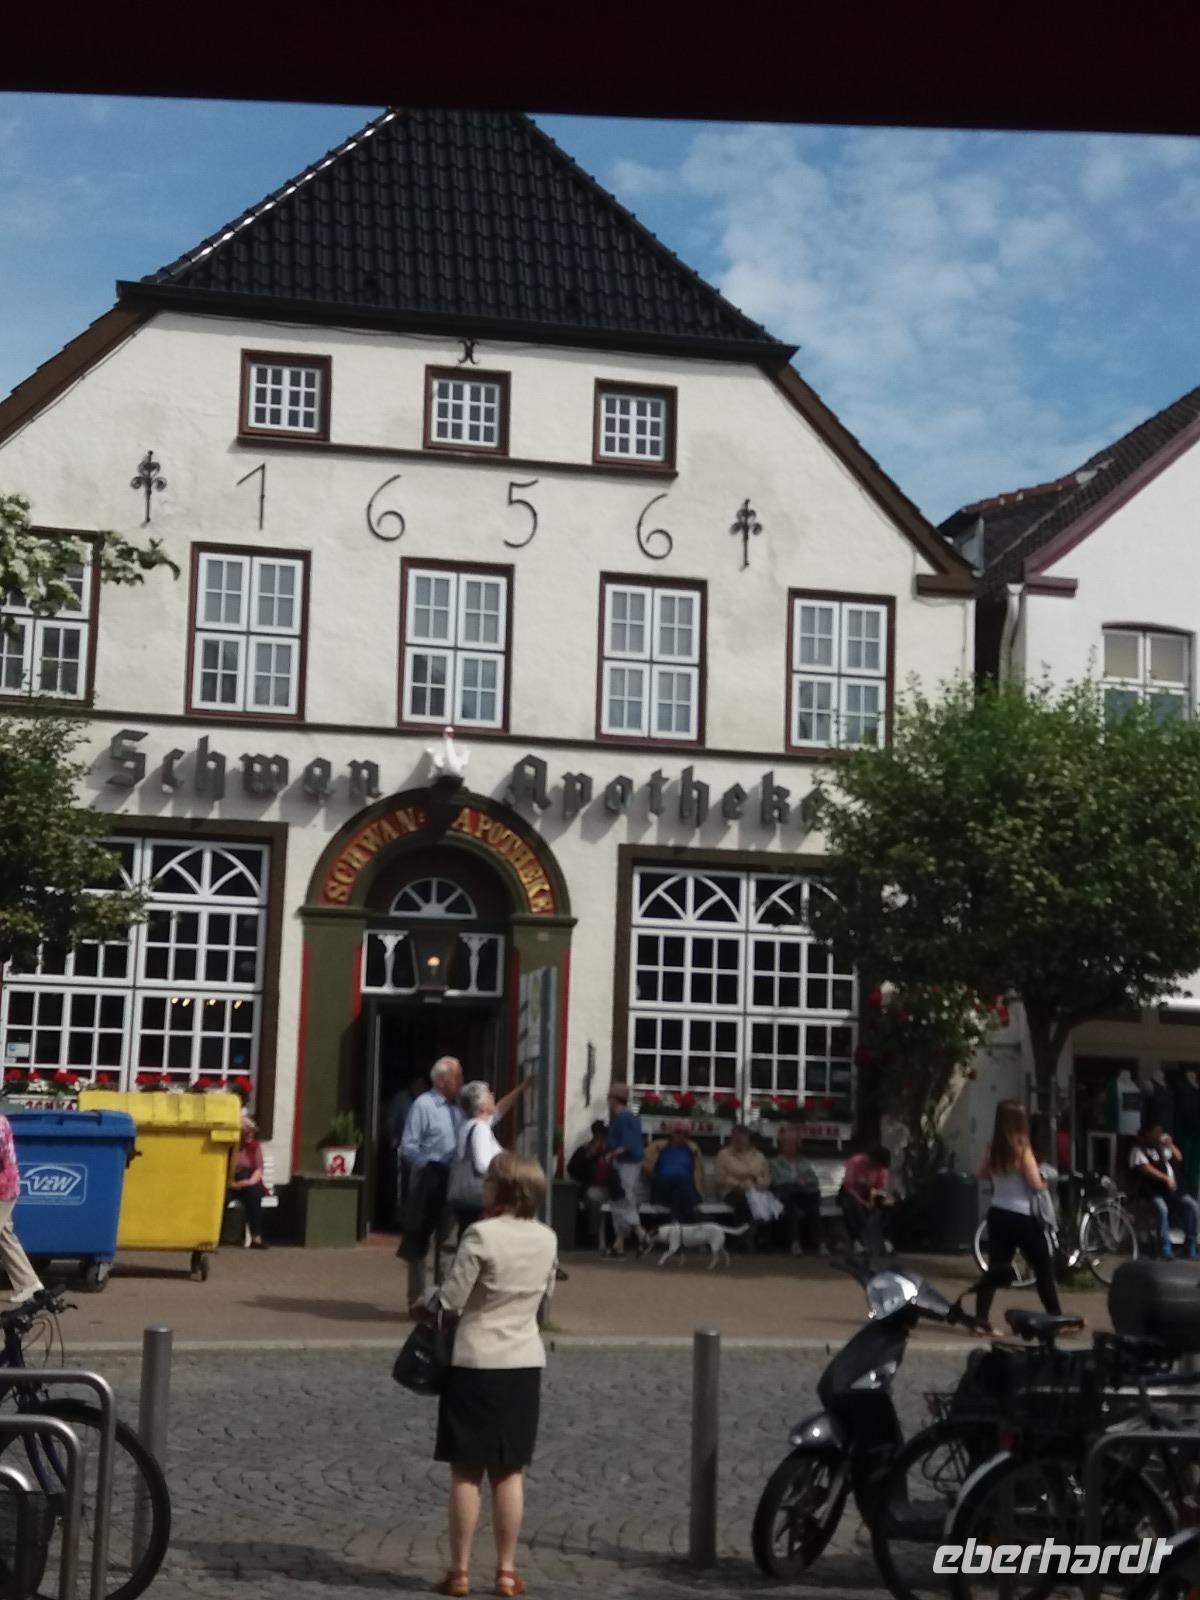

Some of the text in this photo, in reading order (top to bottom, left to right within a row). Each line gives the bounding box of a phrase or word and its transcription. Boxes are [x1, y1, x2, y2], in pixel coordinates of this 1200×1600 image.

[236, 463, 674, 560] 1656
[105, 728, 383, 802] Schwan
[451, 807, 553, 913] APOTHEKE
